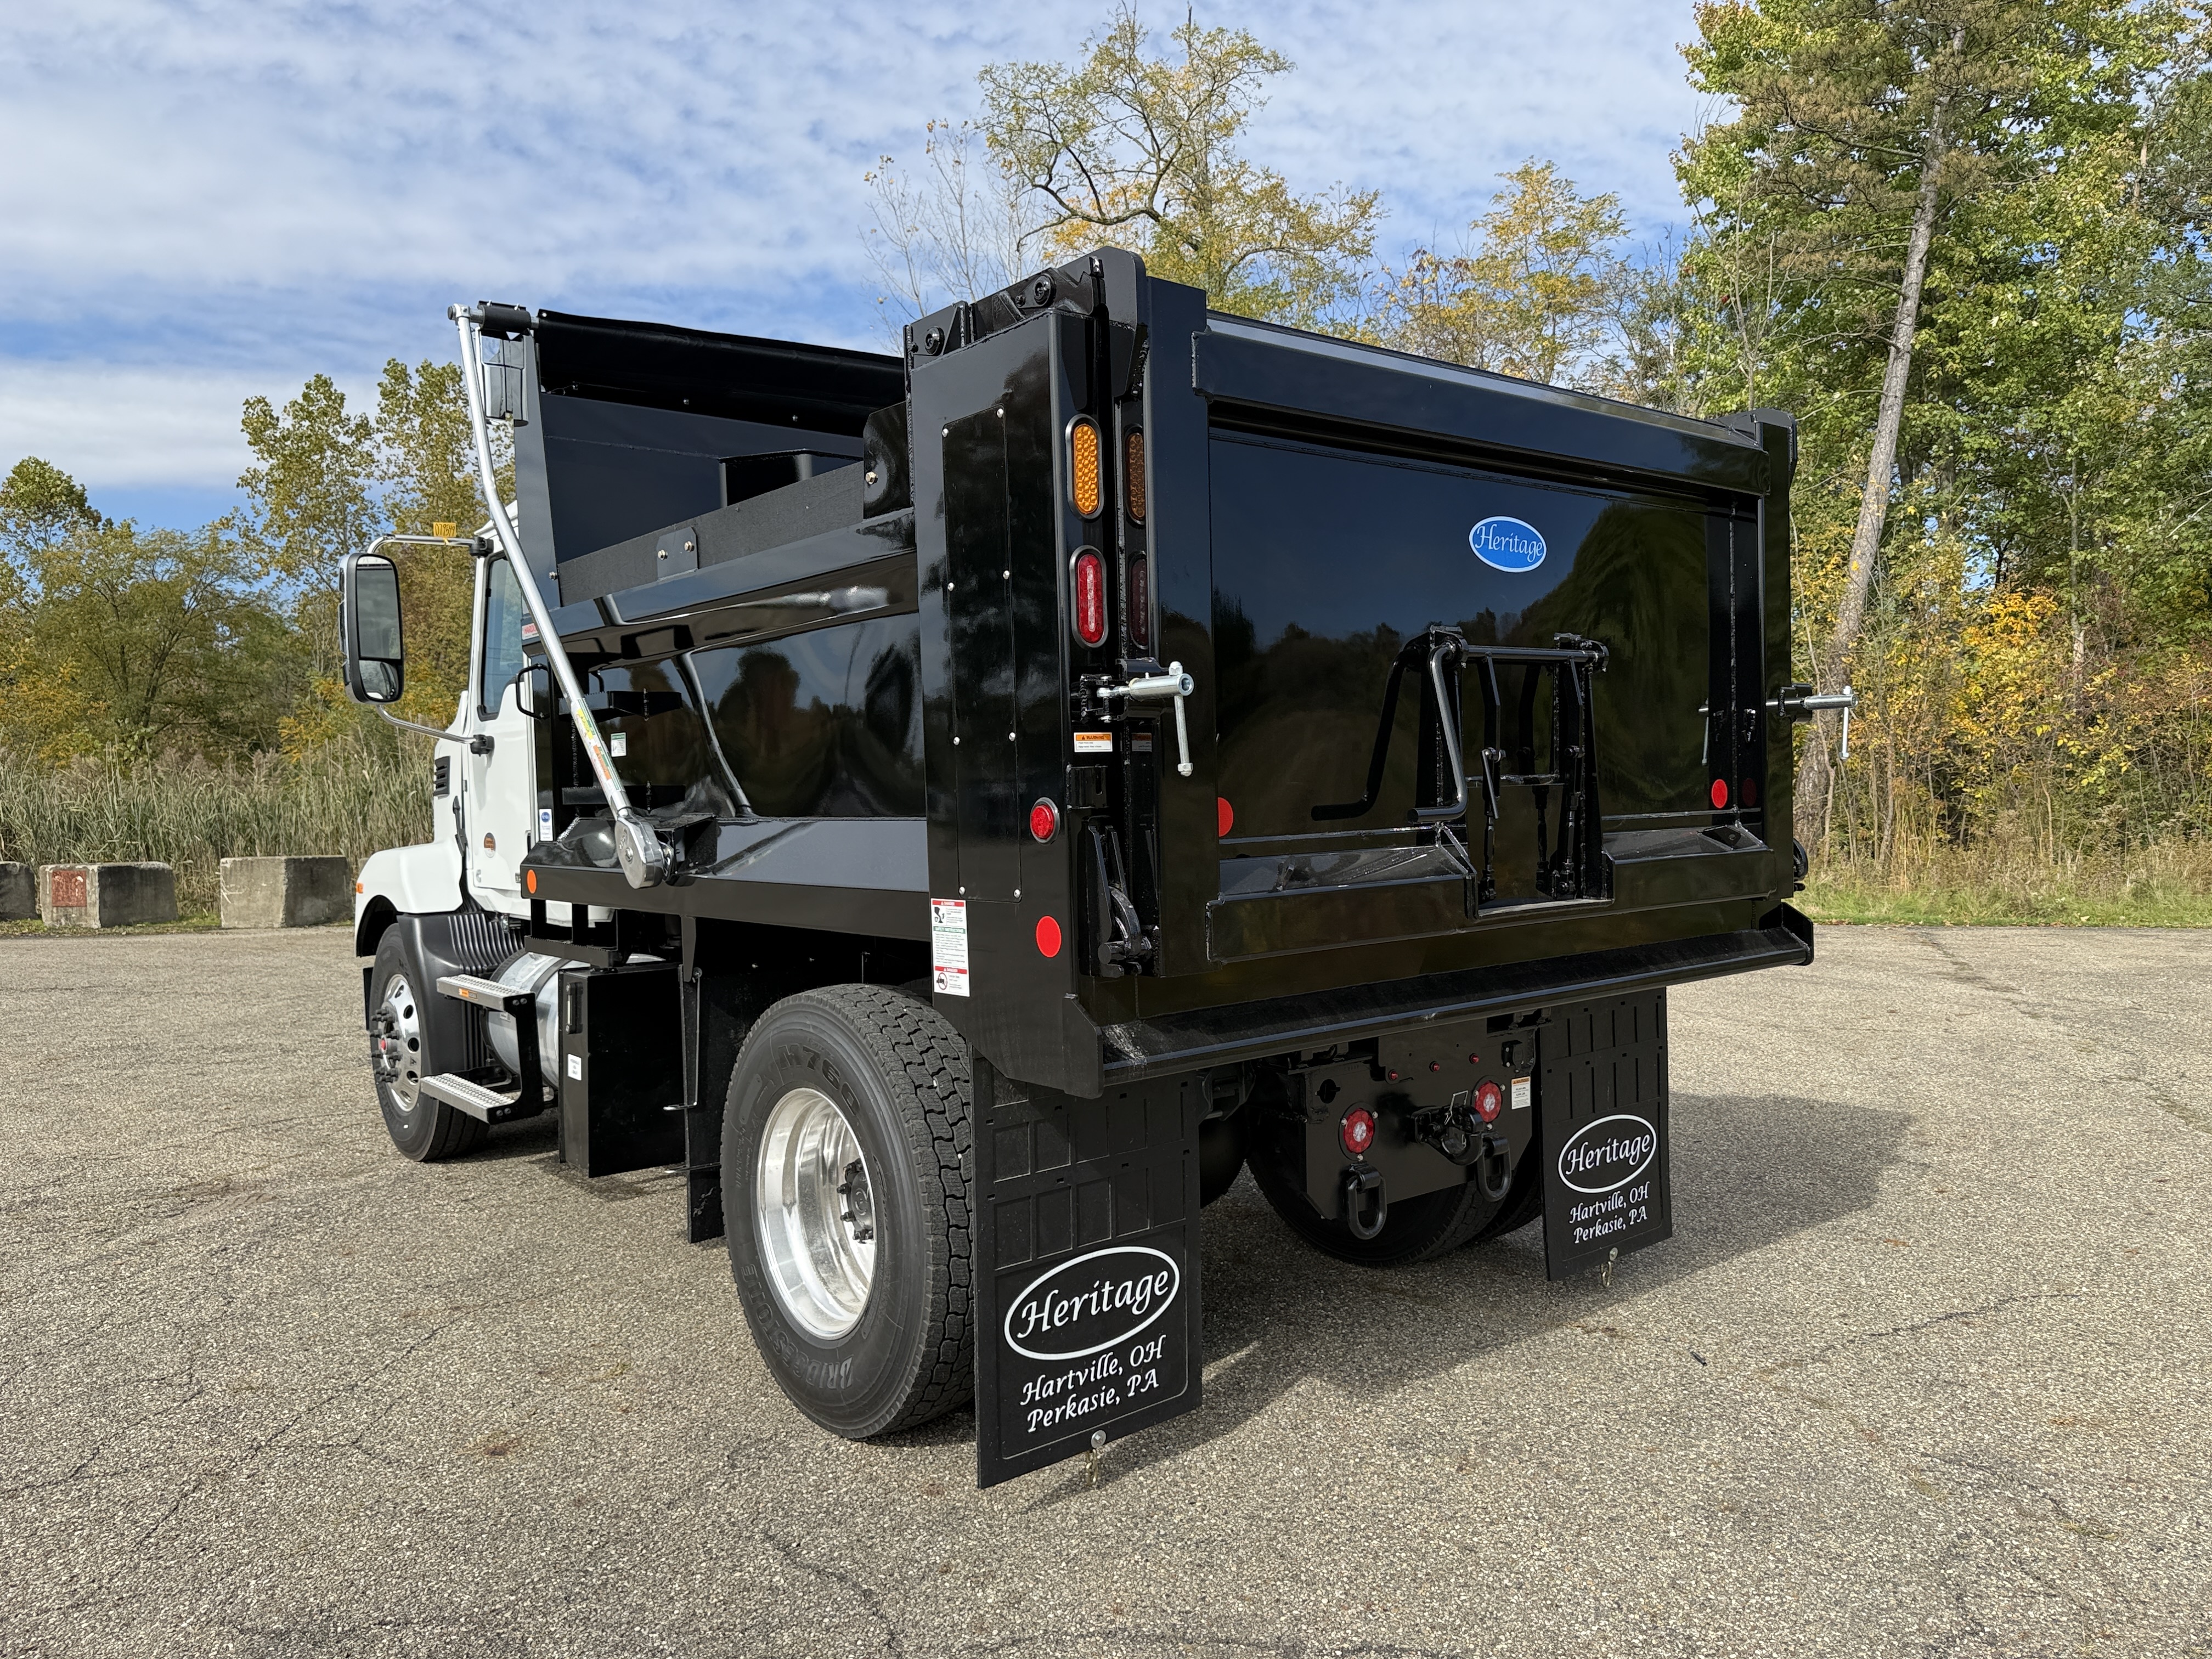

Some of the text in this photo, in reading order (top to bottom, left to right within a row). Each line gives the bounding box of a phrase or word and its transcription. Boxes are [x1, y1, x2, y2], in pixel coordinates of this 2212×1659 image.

[1475, 523, 1543, 563] Heritage
[777, 1044, 860, 1116] M760
[1565, 1134, 1651, 1175] Heritage
[1569, 1181, 1650, 1224] Hartville, OH
[1573, 1205, 1648, 1244] Perkasie, PA
[741, 1263, 854, 1390] BRIDGESTONE
[1017, 1270, 1169, 1339] Heritage
[1020, 1334, 1167, 1406] Hartville, OH
[1027, 1369, 1159, 1433] Perkasie, PA
